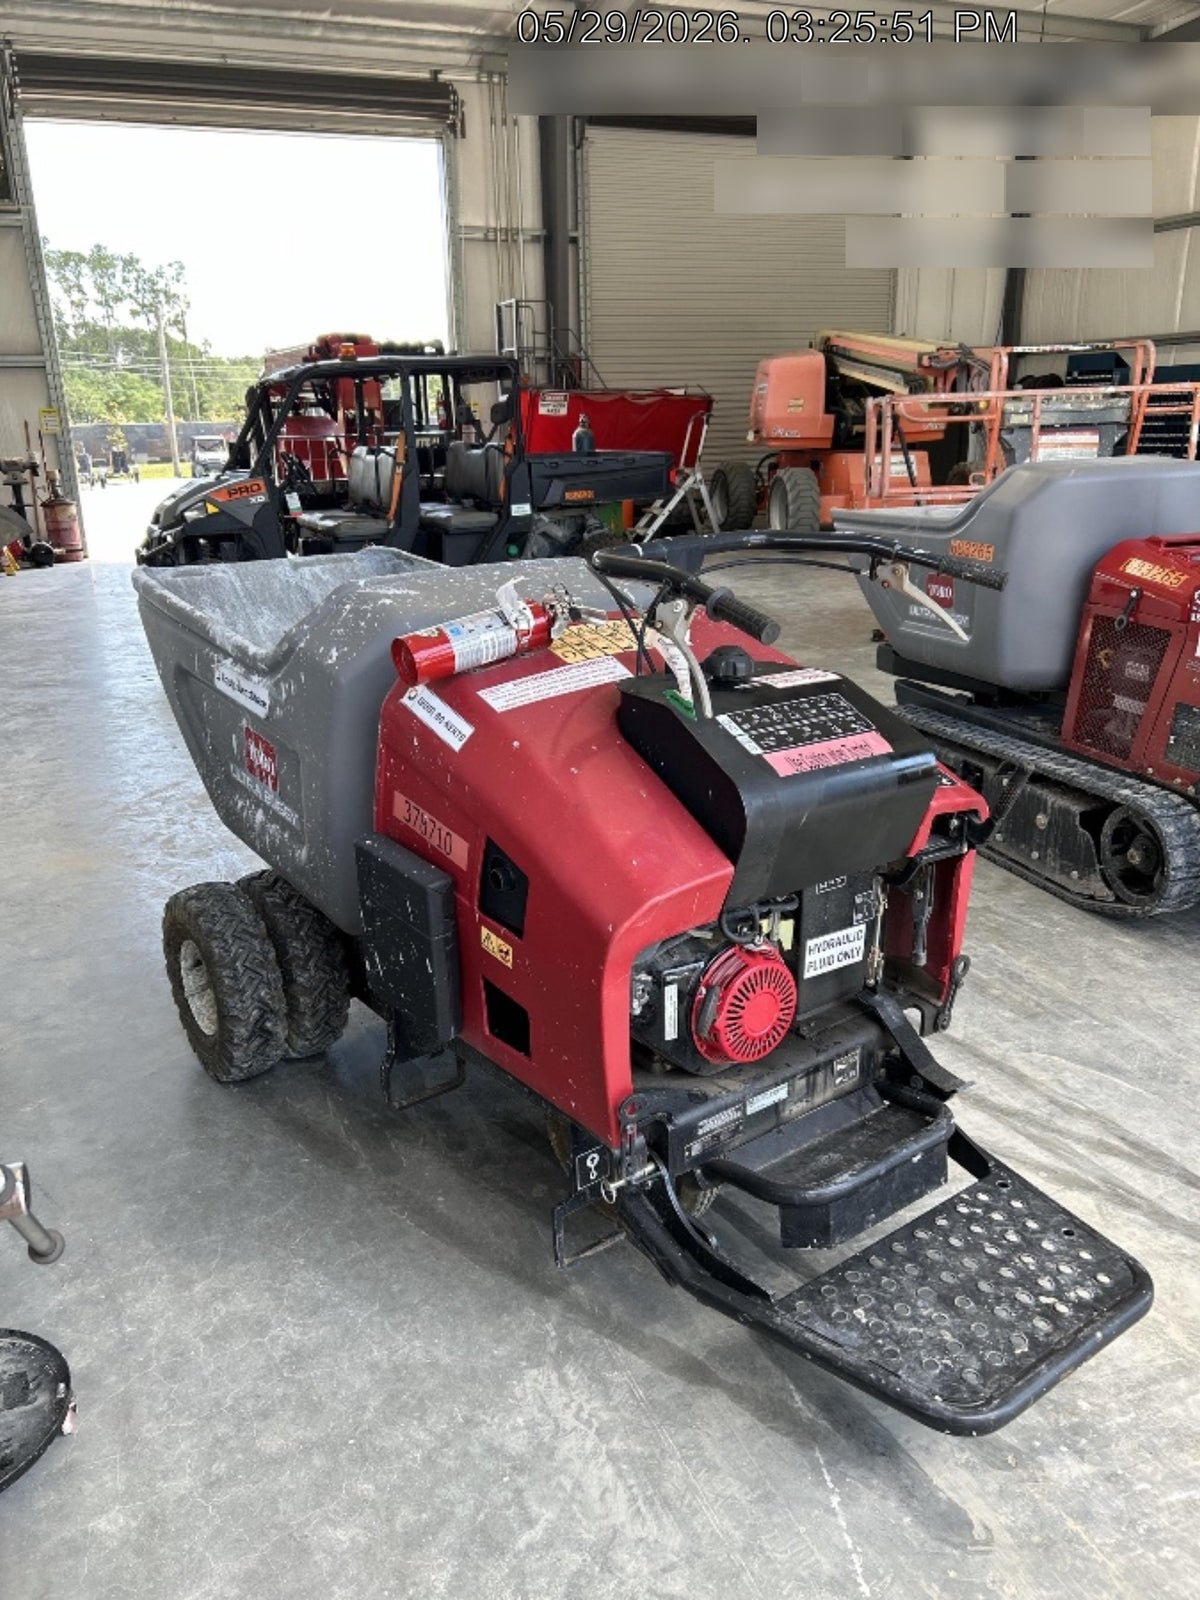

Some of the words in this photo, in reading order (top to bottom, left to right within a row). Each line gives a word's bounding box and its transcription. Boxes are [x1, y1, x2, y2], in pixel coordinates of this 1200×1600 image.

[227, 483, 262, 498] PRO
[950, 541, 991, 560] 3265
[1122, 558, 1184, 586] 3265
[403, 799, 453, 856] 379710
[808, 929, 863, 956] HYDRAULIC
[806, 954, 835, 973] FLUID
[837, 946, 862, 962] ONLY
